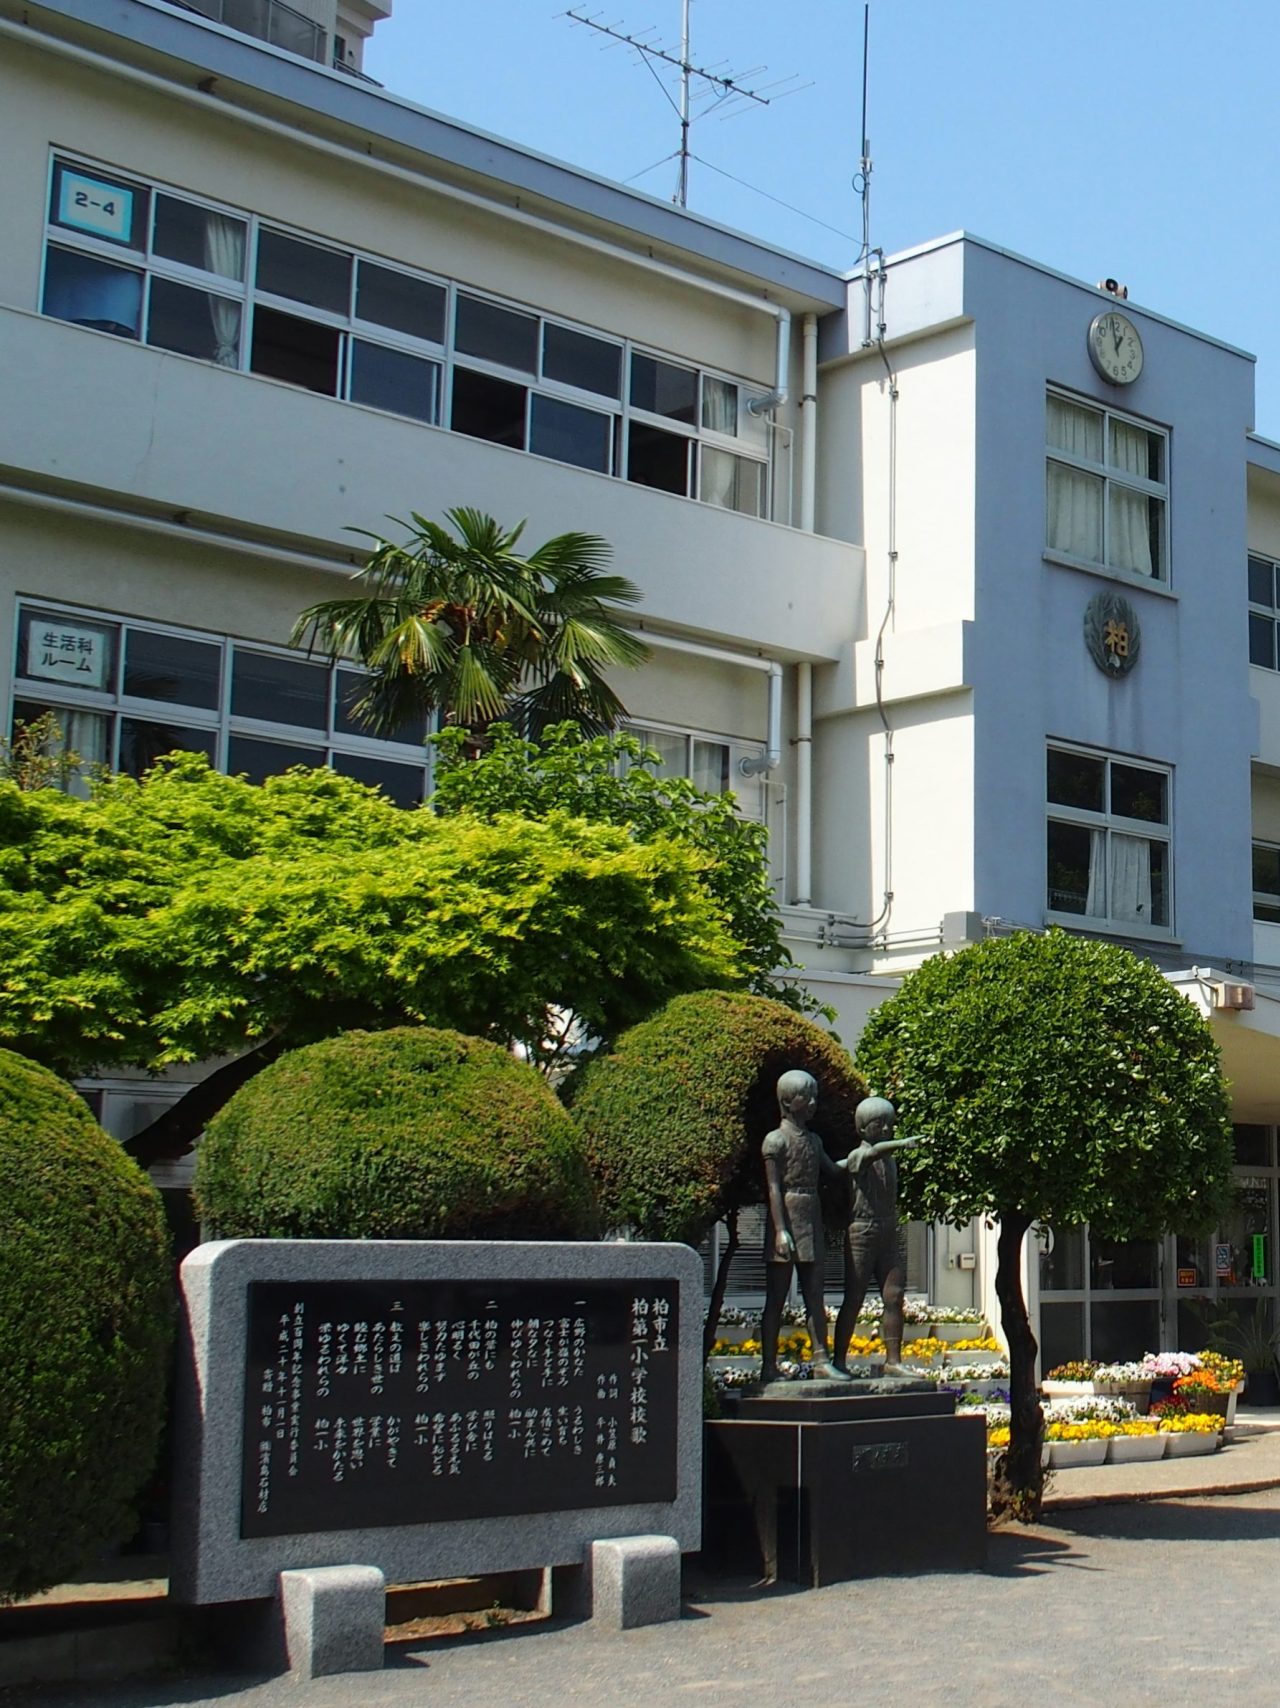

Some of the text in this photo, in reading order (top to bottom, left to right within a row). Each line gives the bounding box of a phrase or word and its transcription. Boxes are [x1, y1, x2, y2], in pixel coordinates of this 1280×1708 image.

[75, 191, 115, 216] 2-4
[41, 631, 94, 655] 生活科
[1104, 619, 1129, 656] 柏
[41, 652, 92, 673] ルーム
[451, 1320, 466, 1361] 心明るく
[652, 1298, 670, 1352] 柏市立
[484, 1320, 498, 1370] 柏の葉にも
[541, 1320, 555, 1388] つなぐ手と手に
[630, 1298, 650, 1444] 柏第一小学校校歌
[313, 1418, 330, 1451] 柏一小
[413, 1413, 429, 1446] 柏一小
[507, 1408, 522, 1439] 柏一小
[571, 1405, 585, 1456] うるわしき
